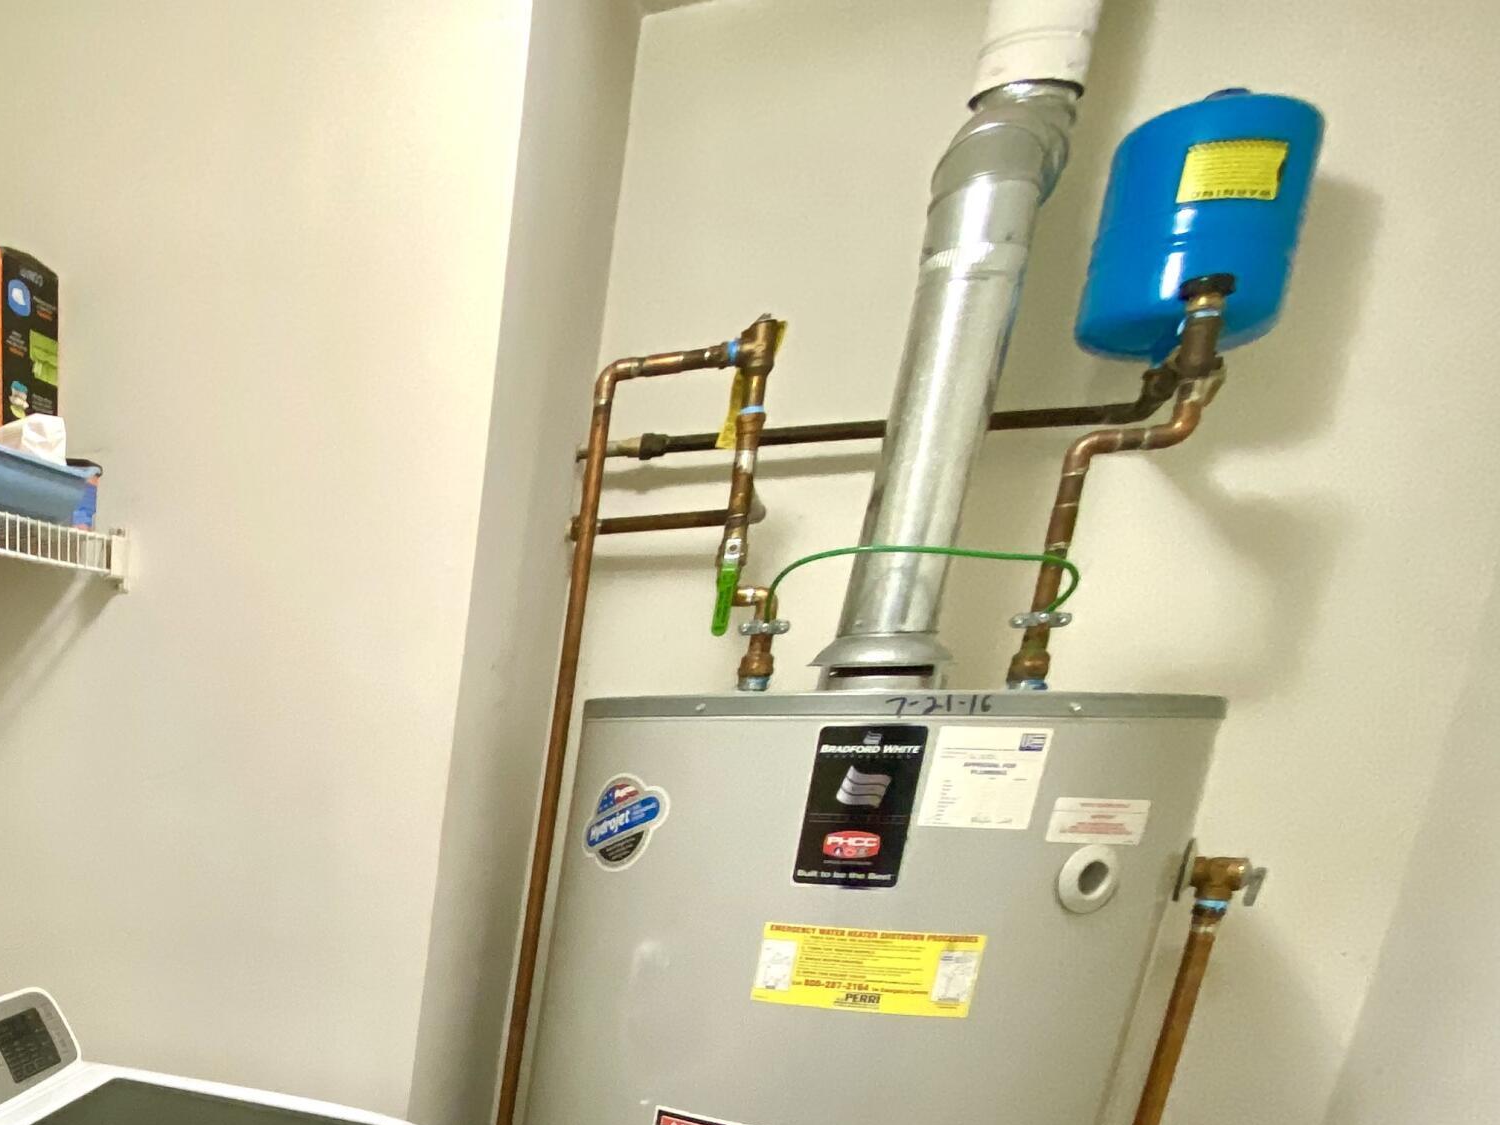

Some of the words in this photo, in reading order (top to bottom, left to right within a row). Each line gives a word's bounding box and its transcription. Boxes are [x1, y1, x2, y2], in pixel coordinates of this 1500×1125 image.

[885, 694, 993, 718] 7-21-16
[819, 744, 882, 754] BRADFORD
[883, 744, 921, 754] WHITE
[826, 836, 879, 848] PHCC
[844, 992, 882, 1004] PERRI
